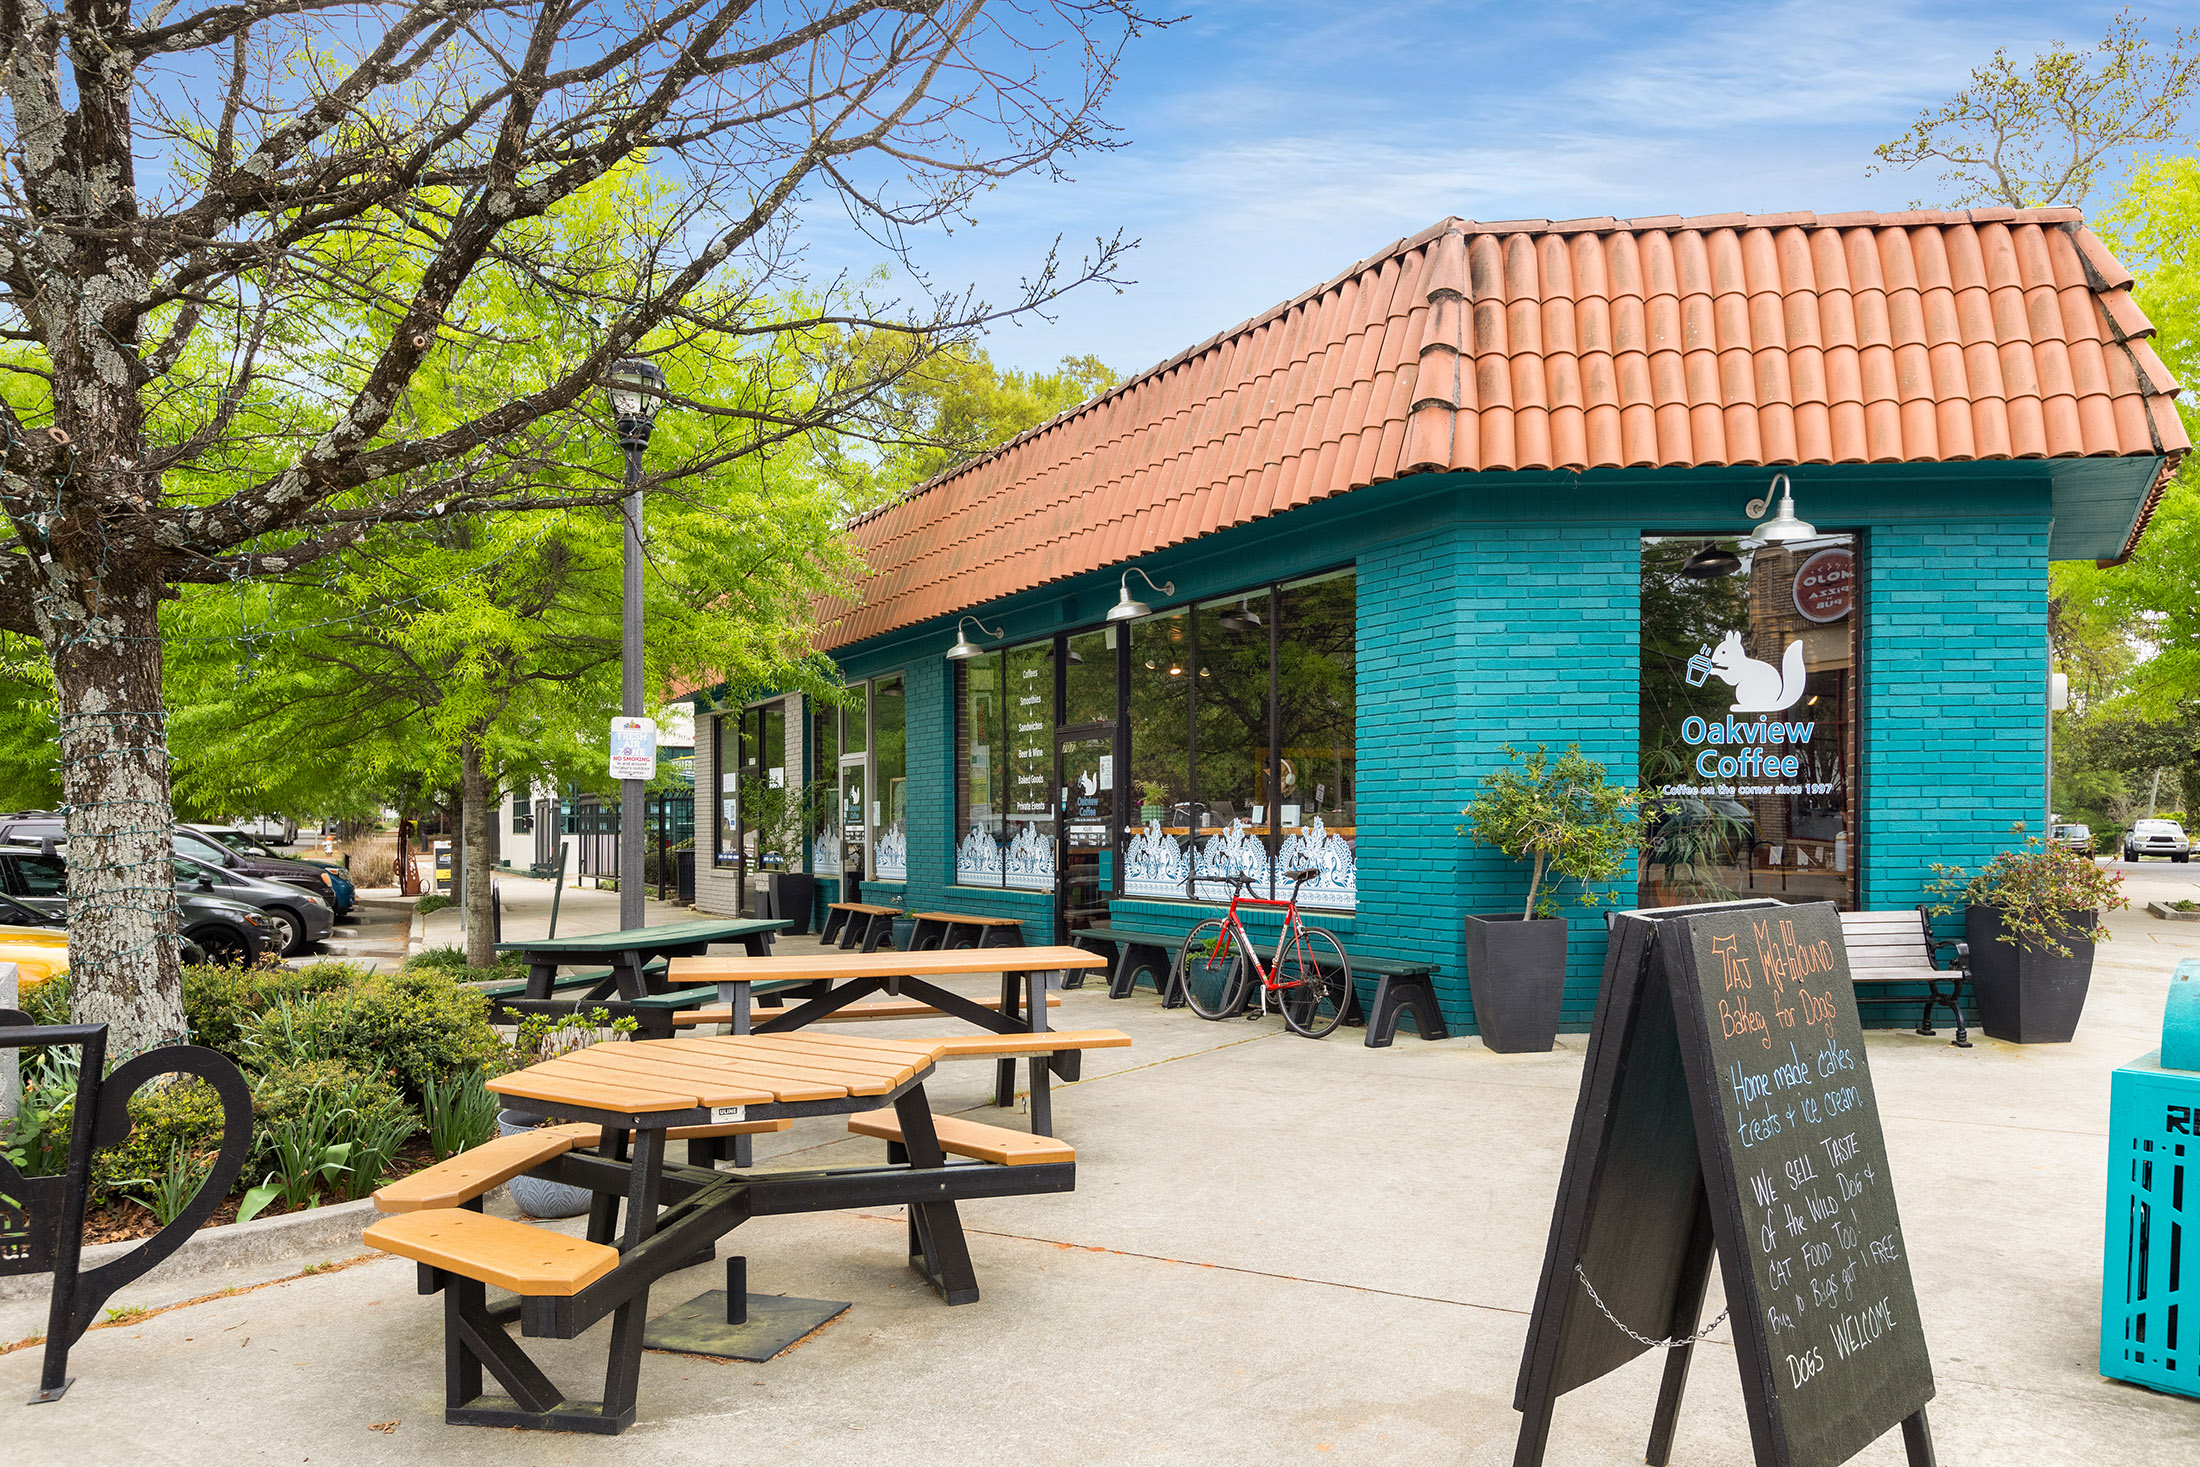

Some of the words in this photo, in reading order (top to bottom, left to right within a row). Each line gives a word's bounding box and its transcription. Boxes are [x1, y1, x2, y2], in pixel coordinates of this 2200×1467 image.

[1020, 694, 1041, 705] Smoothies
[1018, 722, 1042, 732] Sandwiches
[1682, 714, 1815, 744] Oakview
[1018, 749, 1028, 758] Beer
[1033, 748, 1043, 757] Wine
[1696, 747, 1799, 778] Coffee
[1018, 775, 1030, 784] Baked
[1031, 774, 1044, 783] Goods
[1663, 784, 1698, 795] Coffee
[1701, 786, 1715, 795] on
[1718, 784, 1735, 795] the
[1738, 785, 1773, 794] corner
[1775, 784, 1802, 794] since
[1805, 784, 1832, 794] 1997
[1017, 802, 1030, 810] Private
[1031, 802, 1045, 810] Events
[1077, 797, 1099, 806] Oakview
[1080, 806, 1096, 816] Coffee
[1712, 933, 1752, 991] TAJ
[1719, 996, 1771, 1049] Bakery
[1774, 990, 1795, 1029] for
[1799, 989, 1836, 1038] Dogs
[1731, 1061, 1772, 1110] Home
[1773, 1041, 1812, 1089] made
[1818, 1038, 1854, 1078] cakes
[1738, 1101, 1782, 1148] treats
[1798, 1092, 1822, 1123] ice
[1785, 1154, 1818, 1190] SELL
[1820, 1132, 1860, 1168] TASTE
[1784, 1203, 1807, 1237] the
[1769, 1257, 1791, 1291] CAT
[1801, 1242, 1832, 1271] FOOD
[1768, 1306, 1796, 1341] Buy
[1810, 1274, 1838, 1308] Bags
[1786, 1346, 1824, 1390] DOGS
[1829, 1296, 1898, 1360] WELCOME
